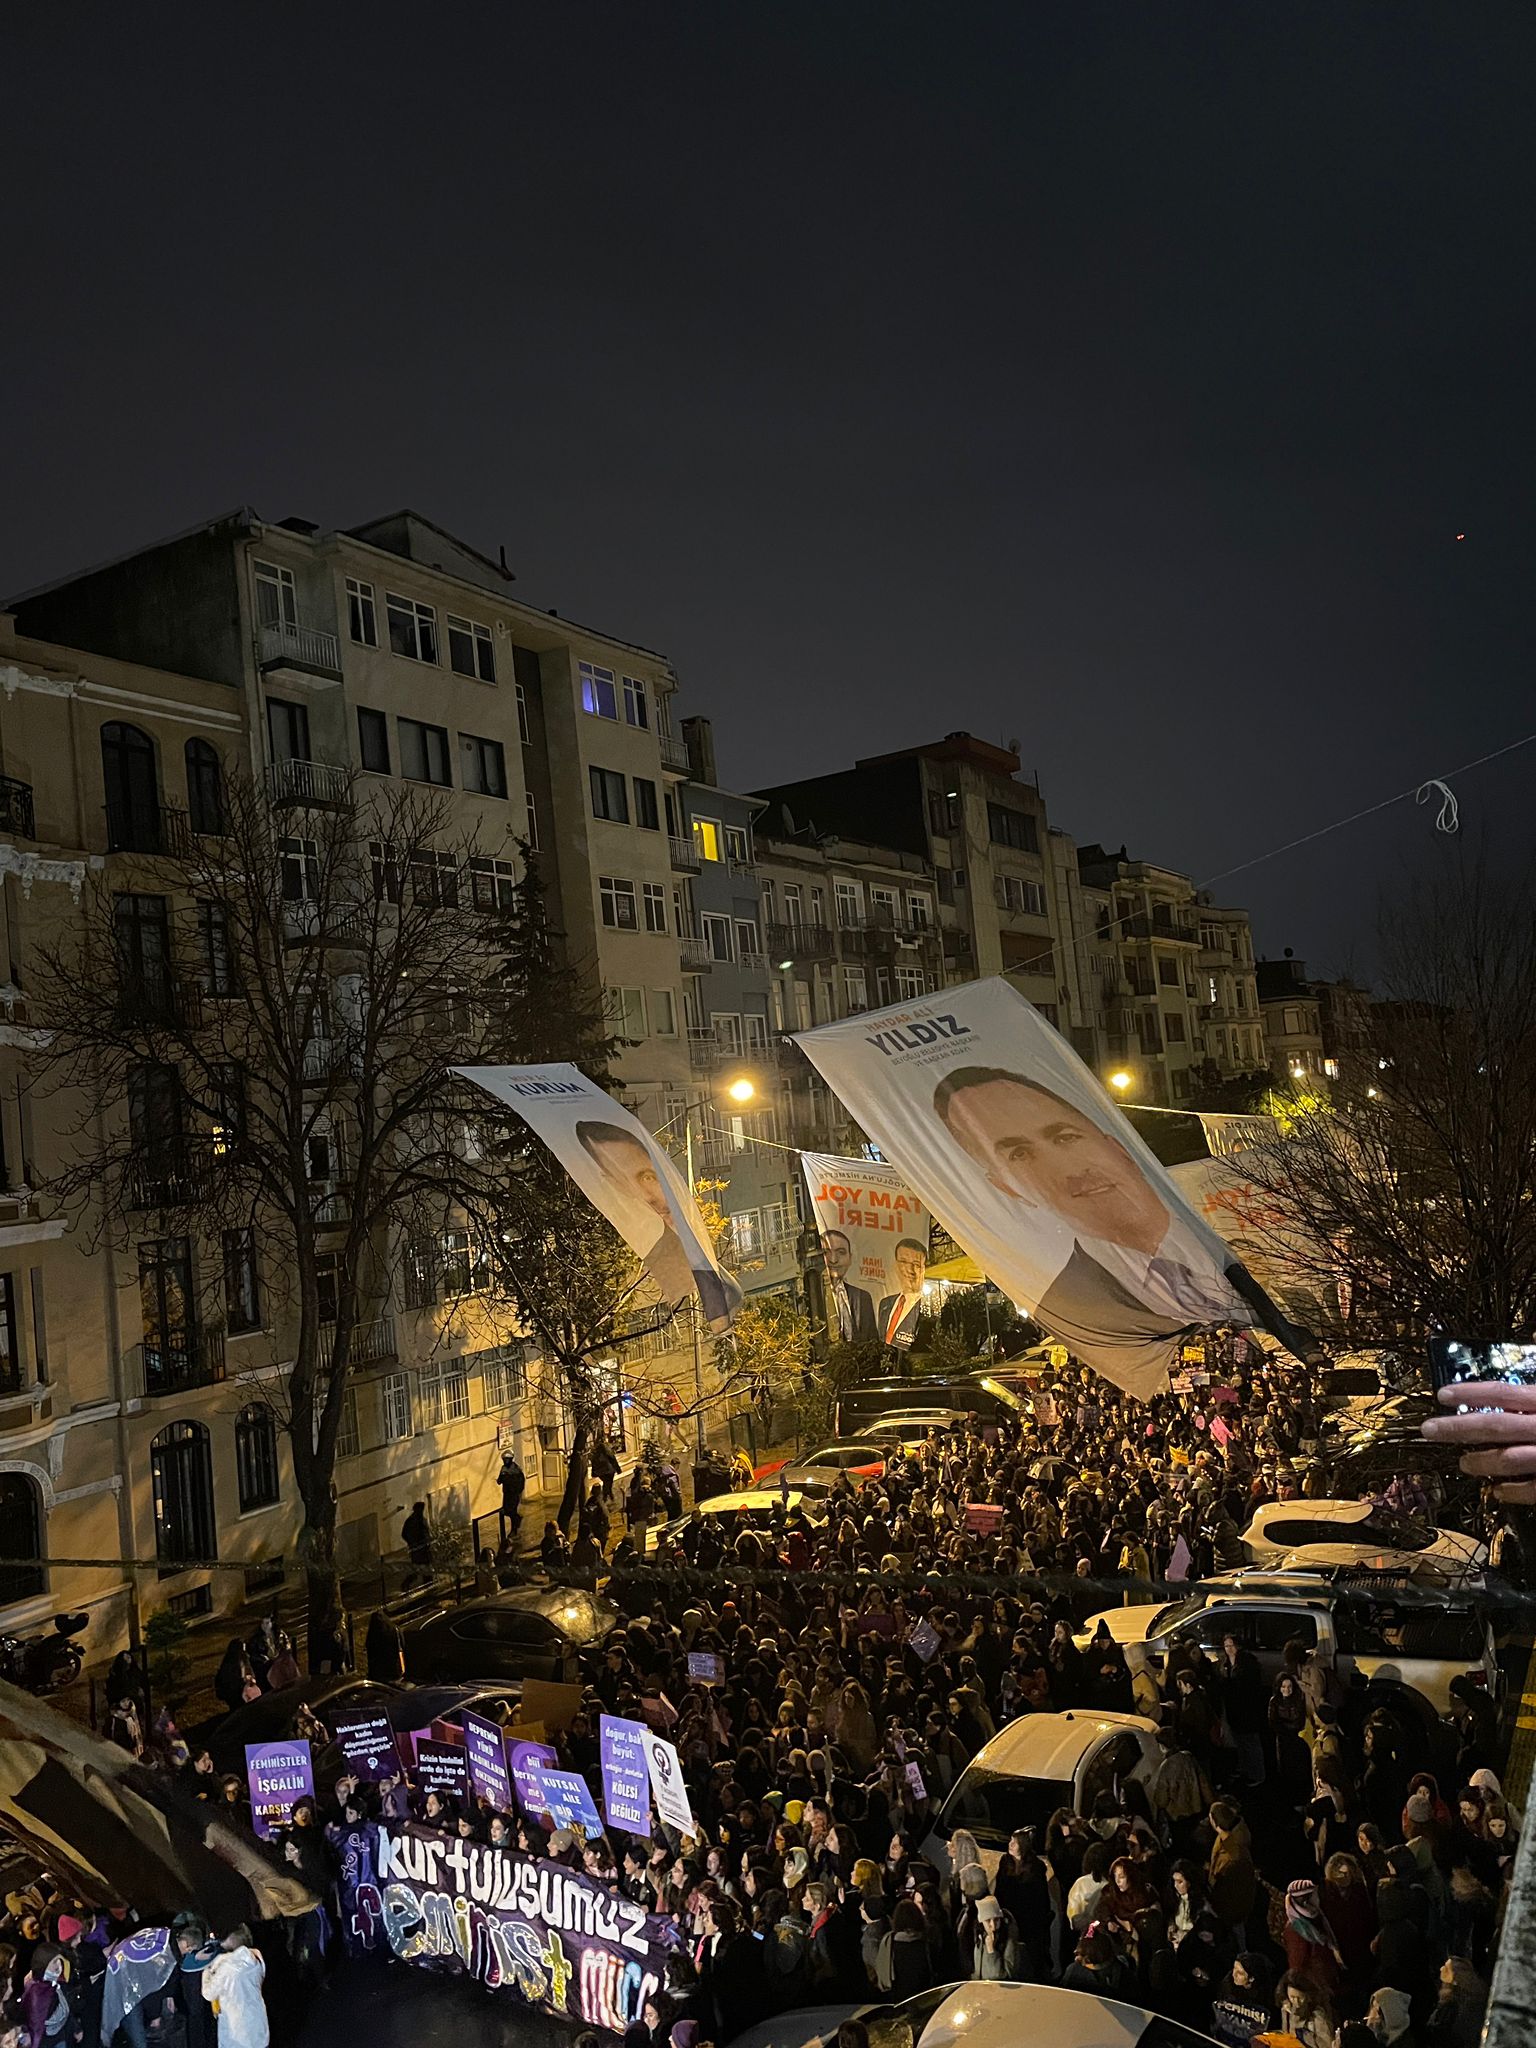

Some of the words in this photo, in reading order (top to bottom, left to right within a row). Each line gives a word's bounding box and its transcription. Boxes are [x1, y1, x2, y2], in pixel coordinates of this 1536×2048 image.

[865, 1014, 971, 1056] YILDIZ
[508, 1081, 587, 1096] KURUM
[250, 1755, 307, 1770] FEMİNİSTLER
[258, 1774, 305, 1795] İŞGALİN
[541, 1776, 582, 1793] KUTSAL
[611, 1779, 638, 1800] KÖLESİ
[562, 1792, 582, 1805] AİLE
[555, 1803, 574, 1818] BİR
[610, 1803, 641, 1823] DEĞİLİZ!
[351, 1883, 572, 2014] feminist
